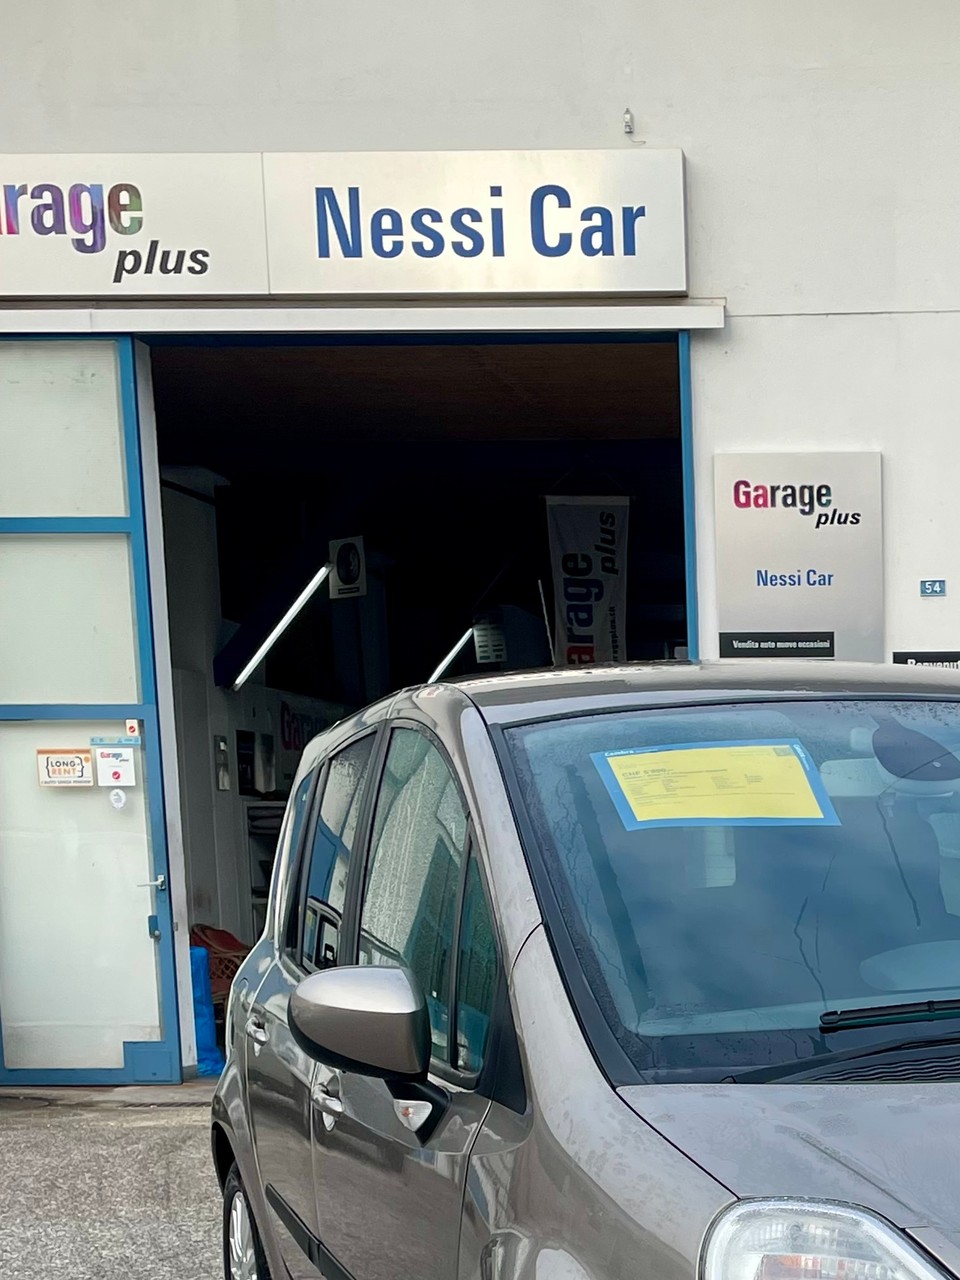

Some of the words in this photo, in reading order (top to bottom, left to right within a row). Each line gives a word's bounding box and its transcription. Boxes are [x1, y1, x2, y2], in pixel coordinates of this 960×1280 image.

[0, 183, 143, 254] rage
[314, 185, 503, 259] Nessi
[530, 184, 646, 257] Car
[112, 239, 210, 284] plus
[733, 480, 833, 516] Garage
[815, 508, 862, 529] plus
[594, 511, 619, 576] plus
[756, 569, 801, 587] Nessi
[806, 569, 834, 587] Car
[925, 582, 941, 593] 54
[561, 552, 605, 665] arage
[732, 640, 759, 649] Vendita
[760, 641, 775, 649] auto
[798, 639, 831, 648] occasioni
[50, 760, 76, 768] LONG
[51, 768, 77, 776] RENT
